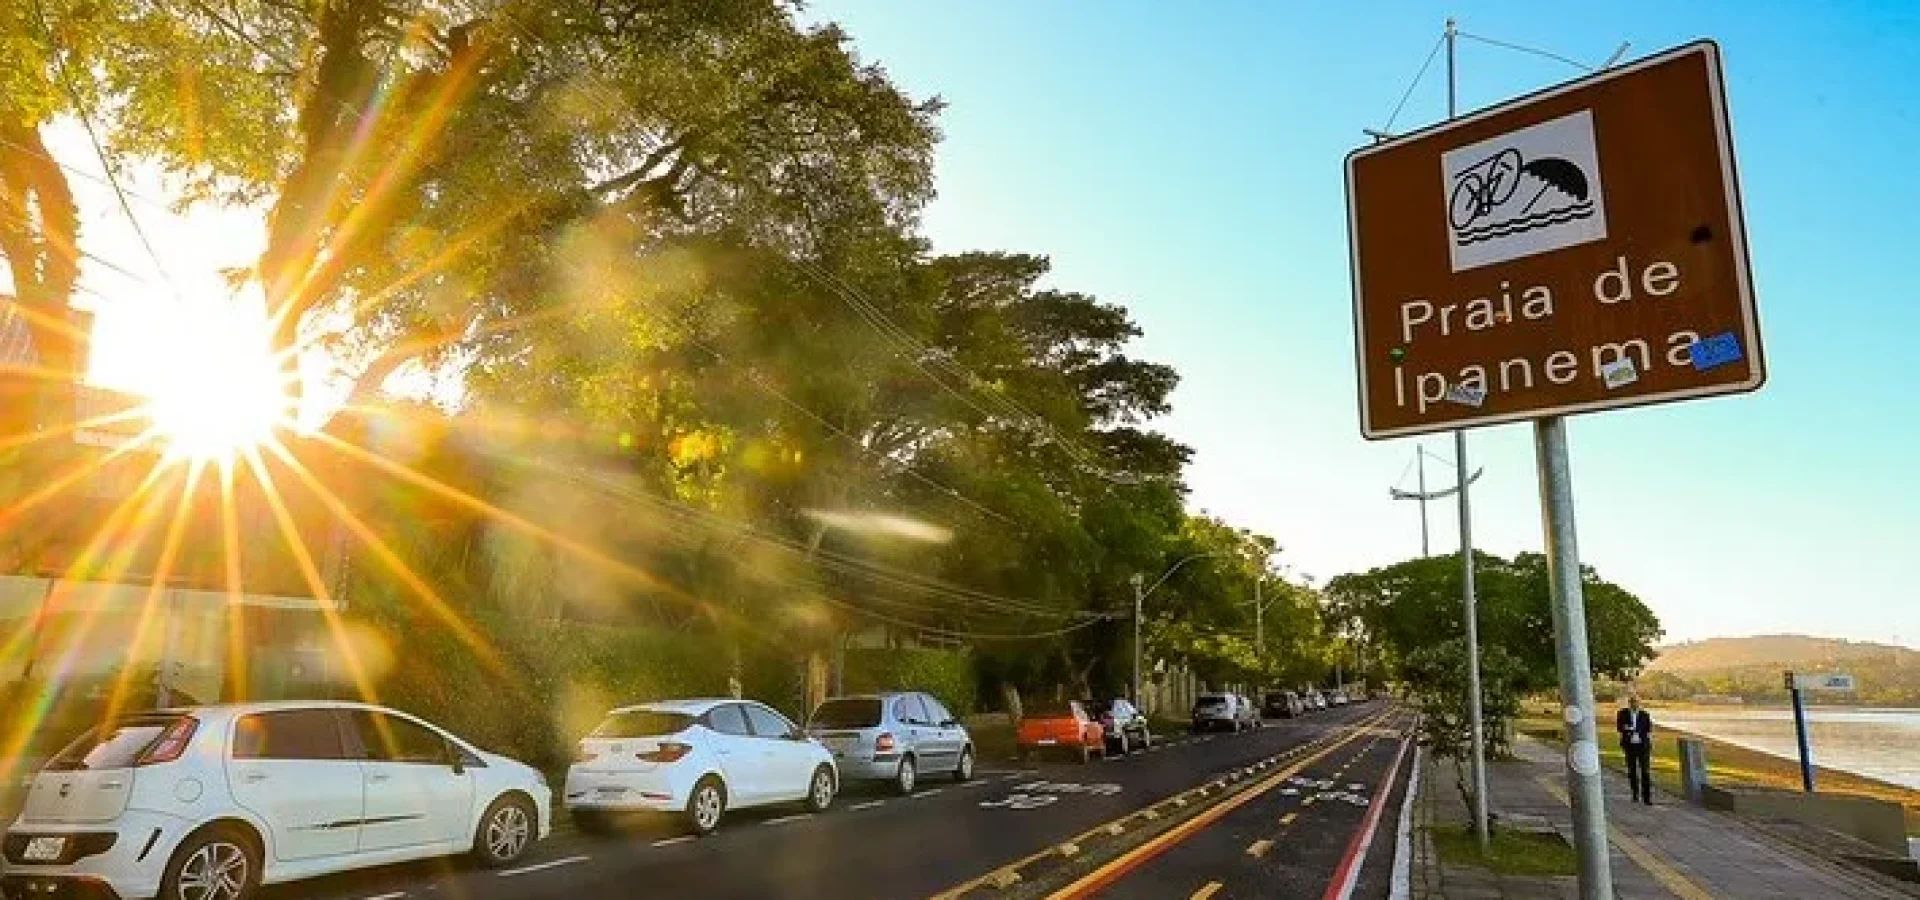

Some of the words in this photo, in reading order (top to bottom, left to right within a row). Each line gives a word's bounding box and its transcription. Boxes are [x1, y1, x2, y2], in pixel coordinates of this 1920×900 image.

[1401, 280, 1553, 343] Praia
[1594, 256, 1680, 303] de
[1394, 330, 1699, 414] Ipanema
